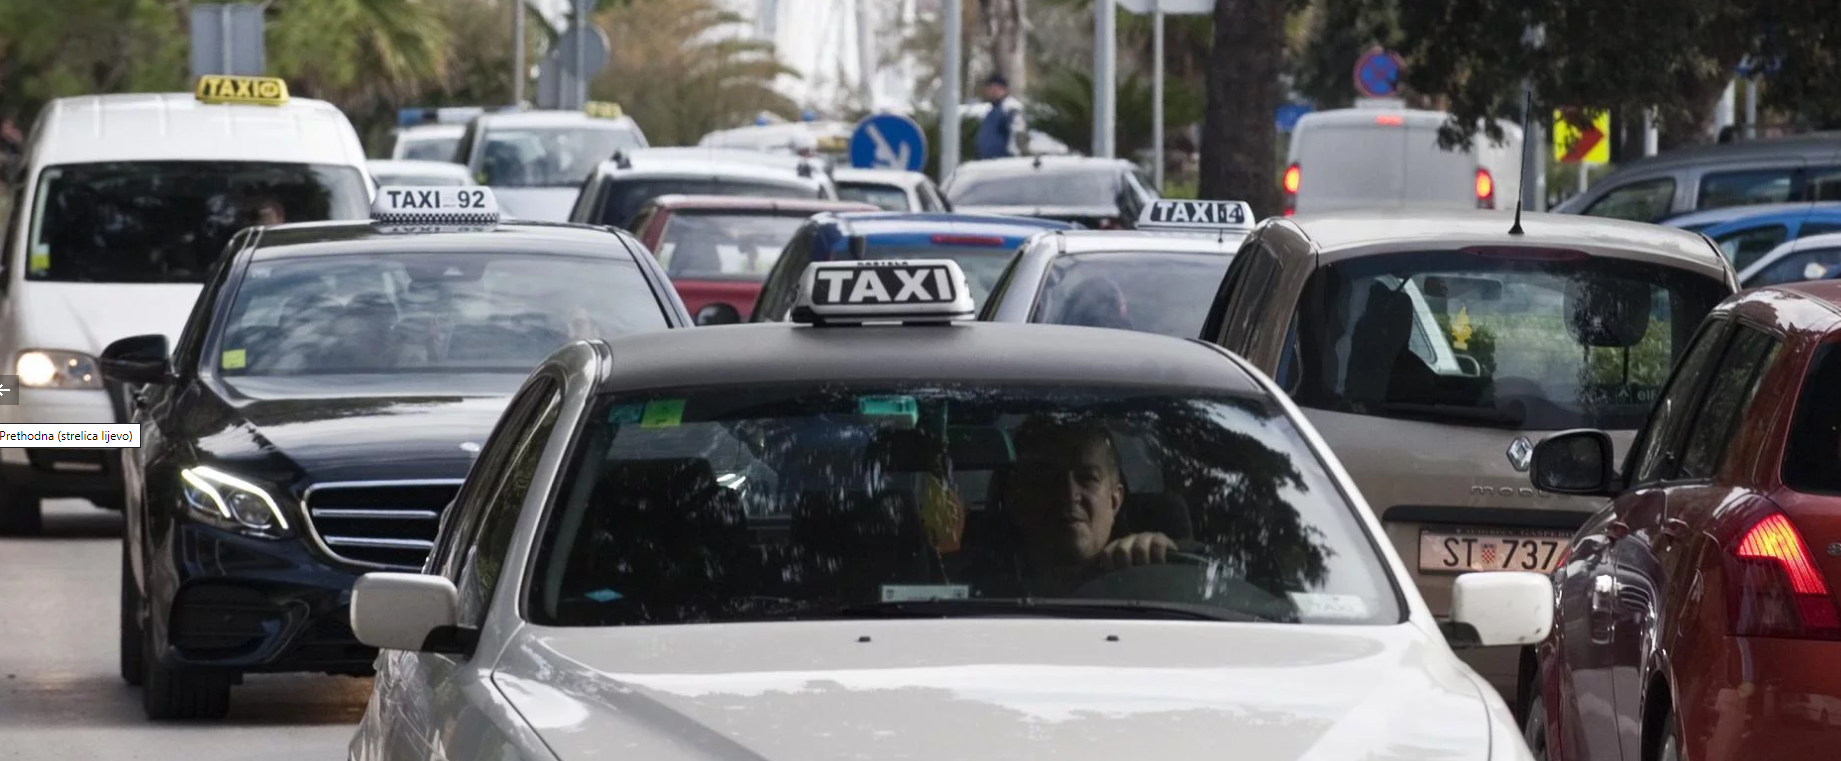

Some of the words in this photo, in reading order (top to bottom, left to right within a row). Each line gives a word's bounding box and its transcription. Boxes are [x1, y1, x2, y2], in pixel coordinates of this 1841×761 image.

[205, 79, 259, 97] TAXI
[387, 190, 441, 208] TAXI
[457, 190, 485, 209] 92
[1157, 202, 1219, 223] TAXI
[817, 268, 953, 303] TAXI
[1443, 538, 1478, 568] ST
[1502, 539, 1558, 571] 737
